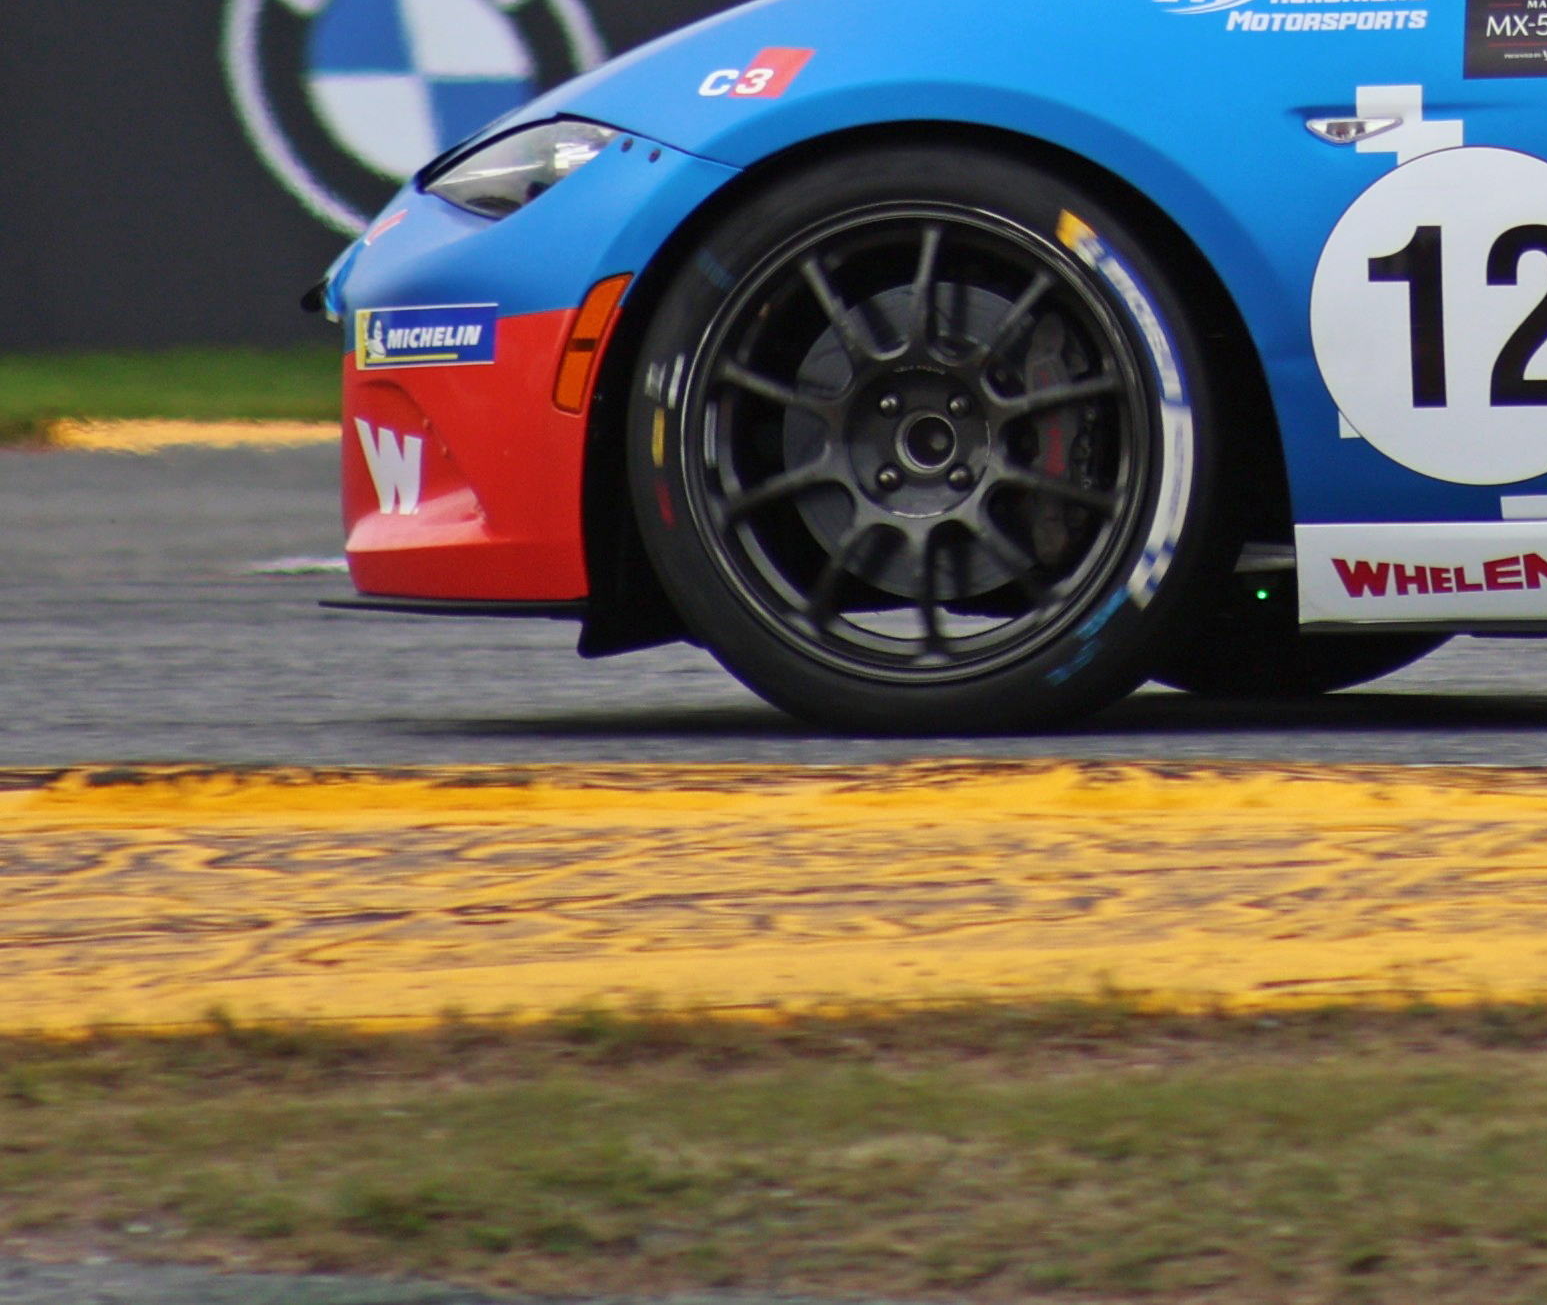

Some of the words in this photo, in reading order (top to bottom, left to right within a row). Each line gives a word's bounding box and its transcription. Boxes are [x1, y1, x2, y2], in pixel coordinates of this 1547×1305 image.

[1226, 9, 1428, 31] MOTORSPORTS
[697, 67, 774, 97] C3
[387, 325, 482, 349] MICHELIN
